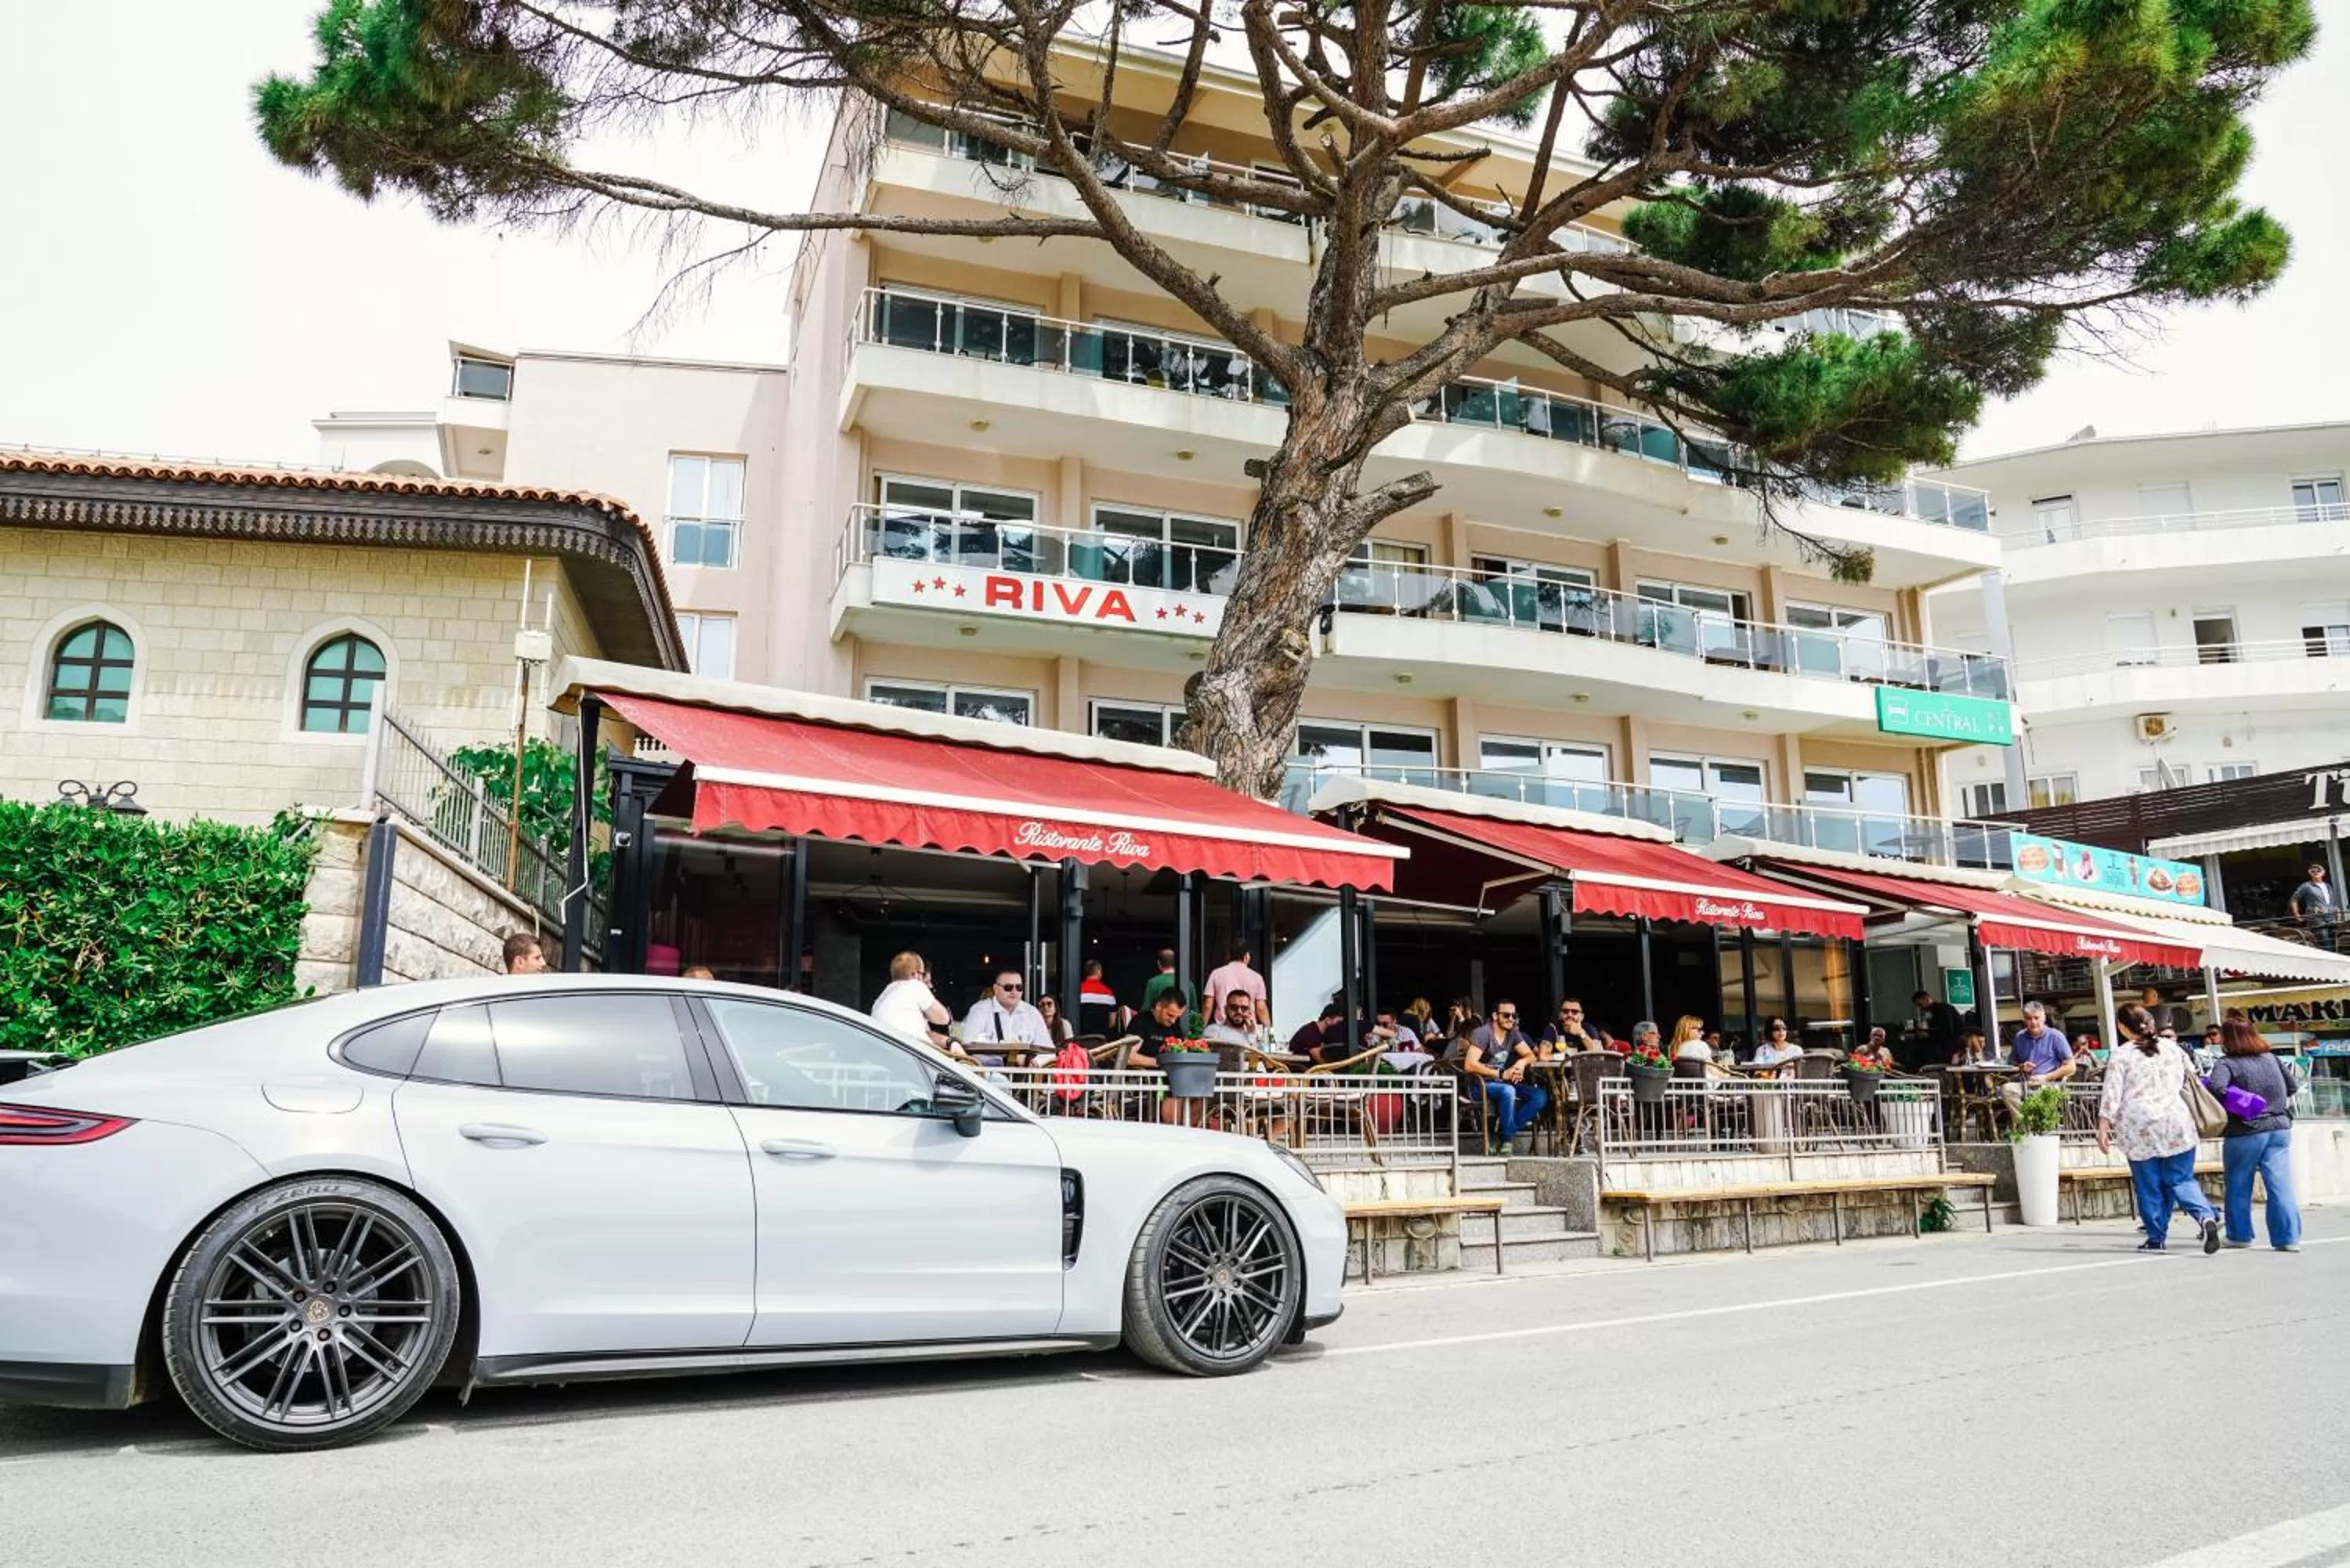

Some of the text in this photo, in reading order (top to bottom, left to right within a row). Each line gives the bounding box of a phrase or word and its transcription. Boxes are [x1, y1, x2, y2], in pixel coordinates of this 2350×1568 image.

[985, 576, 1138, 623] RIVA
[1914, 710, 1981, 734] CENTRAL
[1014, 821, 1152, 858] Ristorante Riva
[2247, 999, 2350, 1023] MAK
